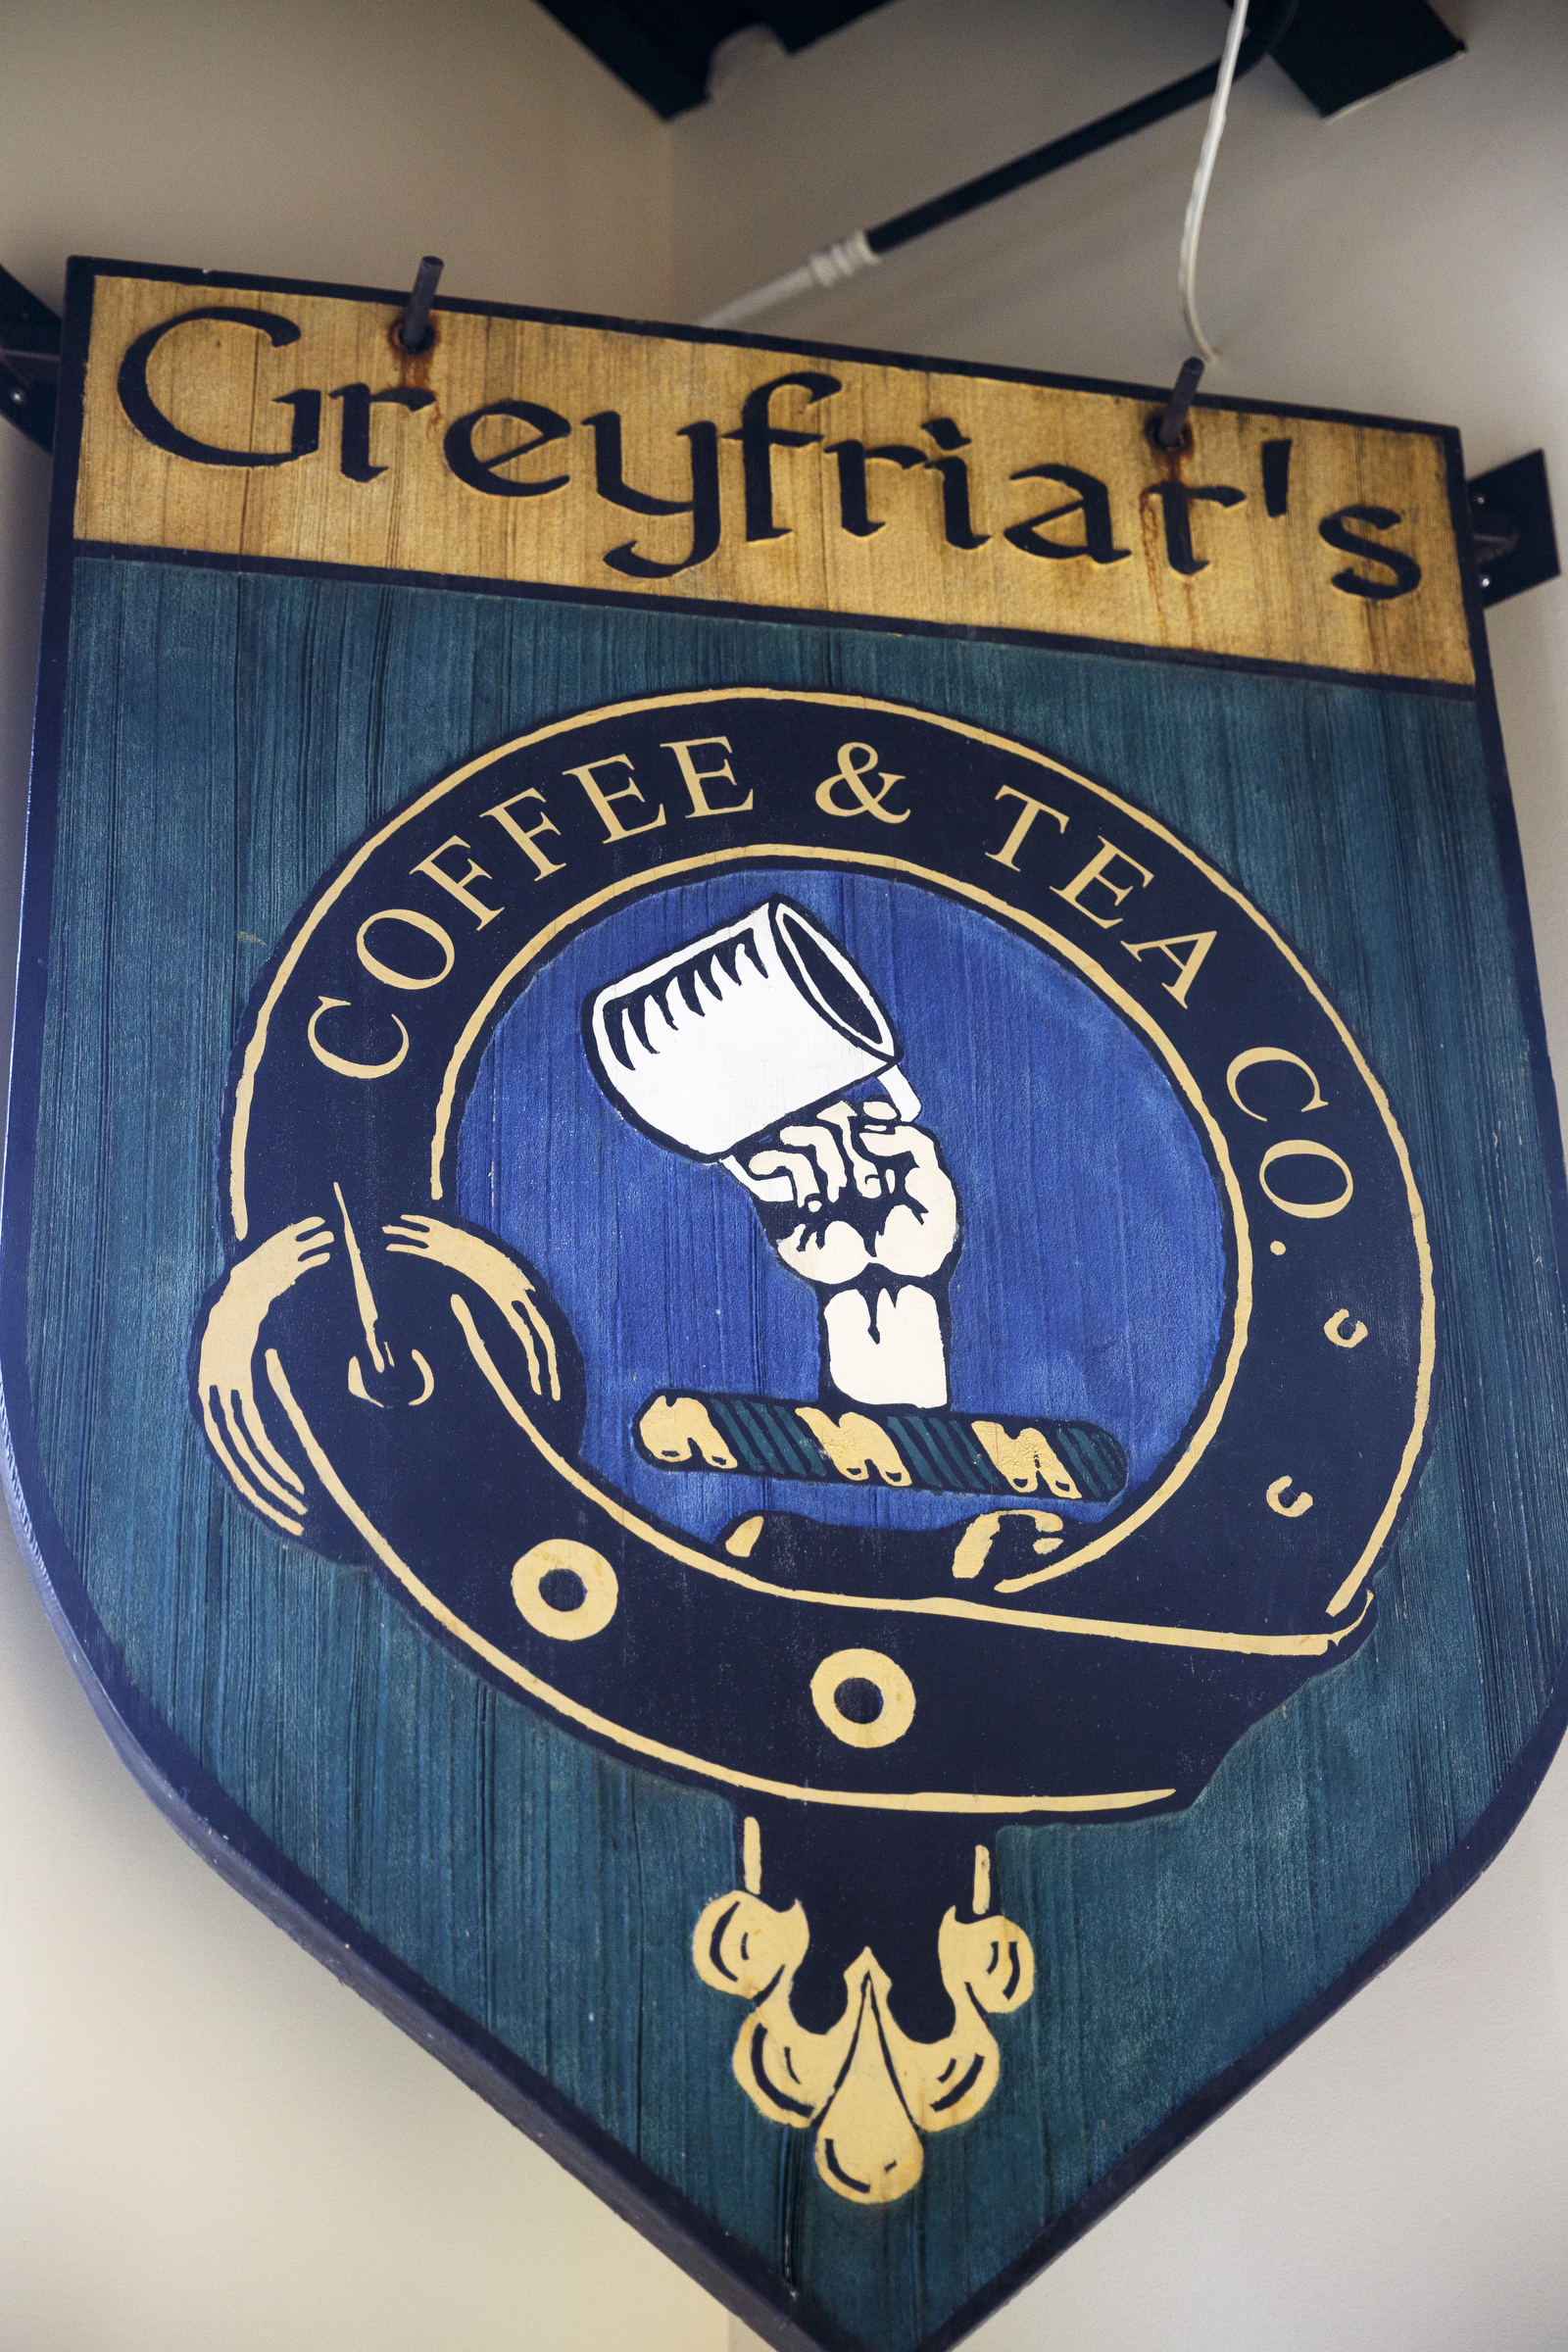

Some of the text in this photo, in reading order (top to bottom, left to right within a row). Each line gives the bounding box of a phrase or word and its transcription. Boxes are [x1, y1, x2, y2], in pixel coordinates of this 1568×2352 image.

[116, 305, 1423, 600] Greyfriar's
[306, 735, 1354, 1256] COFFEE & TEA CO.
